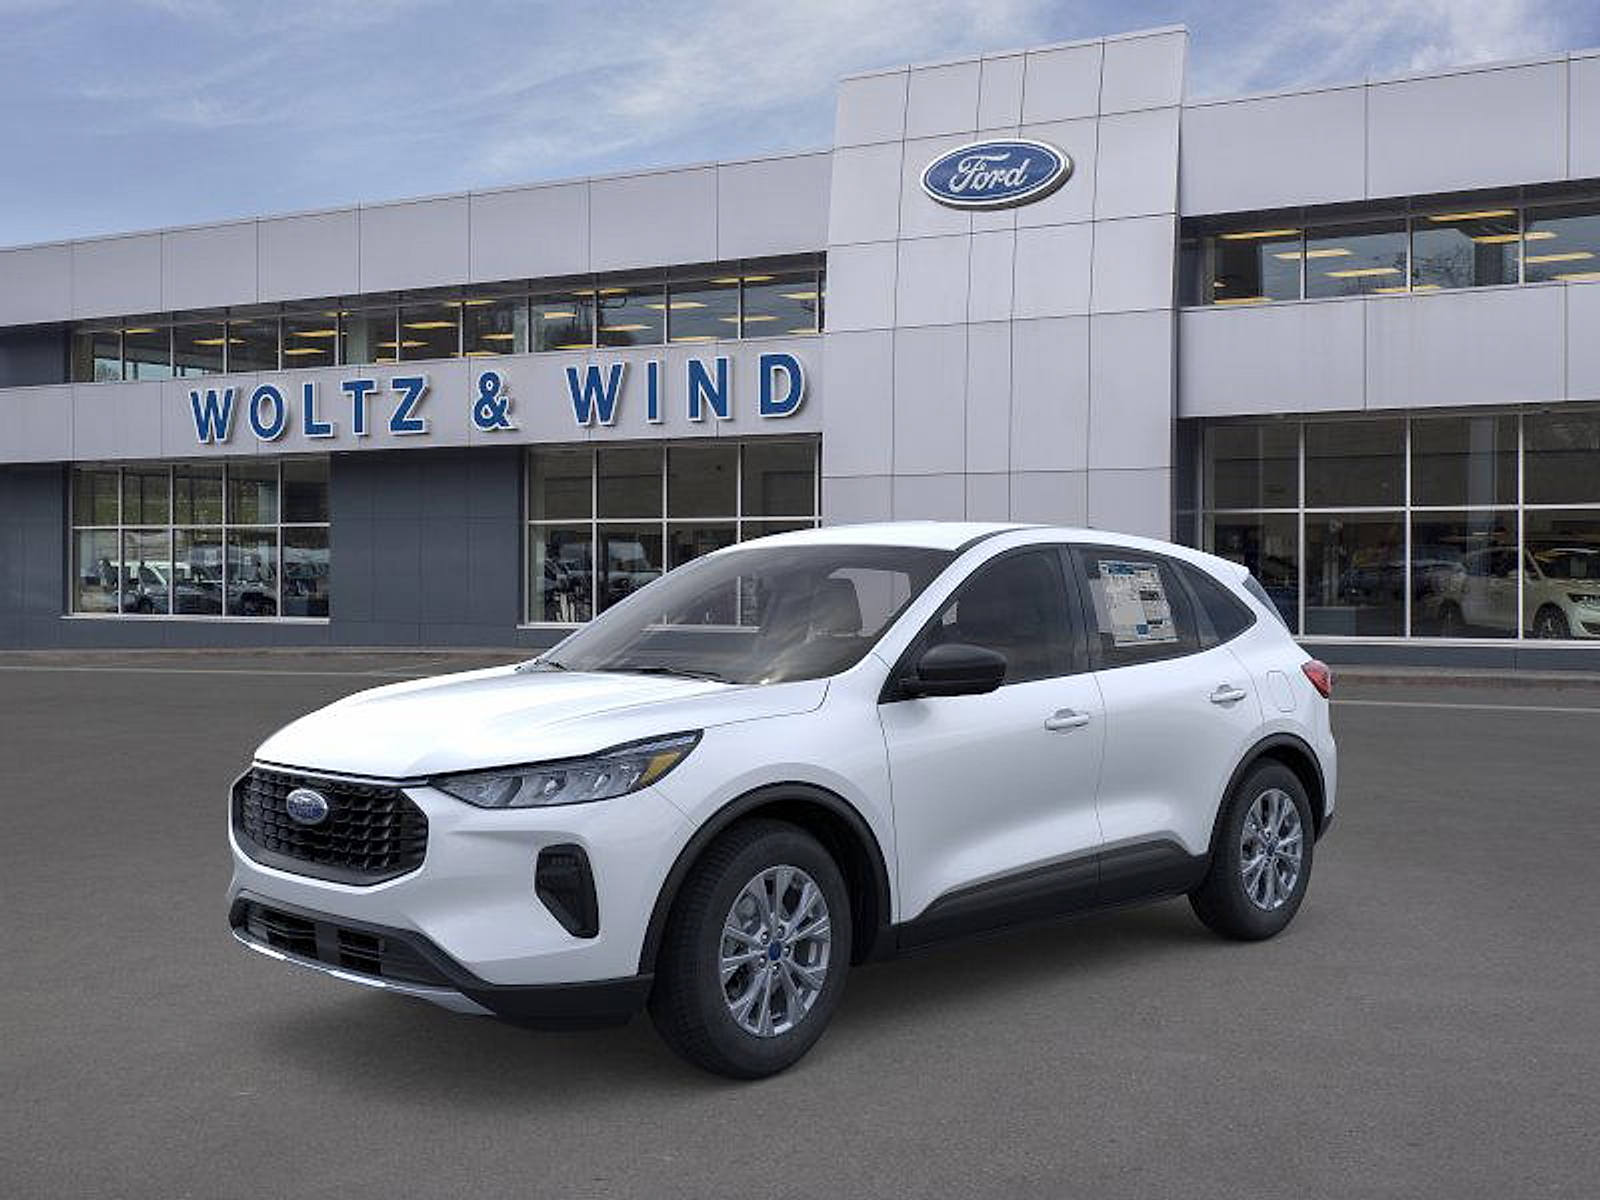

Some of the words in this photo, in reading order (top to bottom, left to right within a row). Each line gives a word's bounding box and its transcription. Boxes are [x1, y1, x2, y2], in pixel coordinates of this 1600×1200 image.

[949, 152, 1031, 193] Ford
[190, 375, 429, 443] WOLTZ
[472, 371, 515, 431] &
[564, 352, 805, 426] WIND
